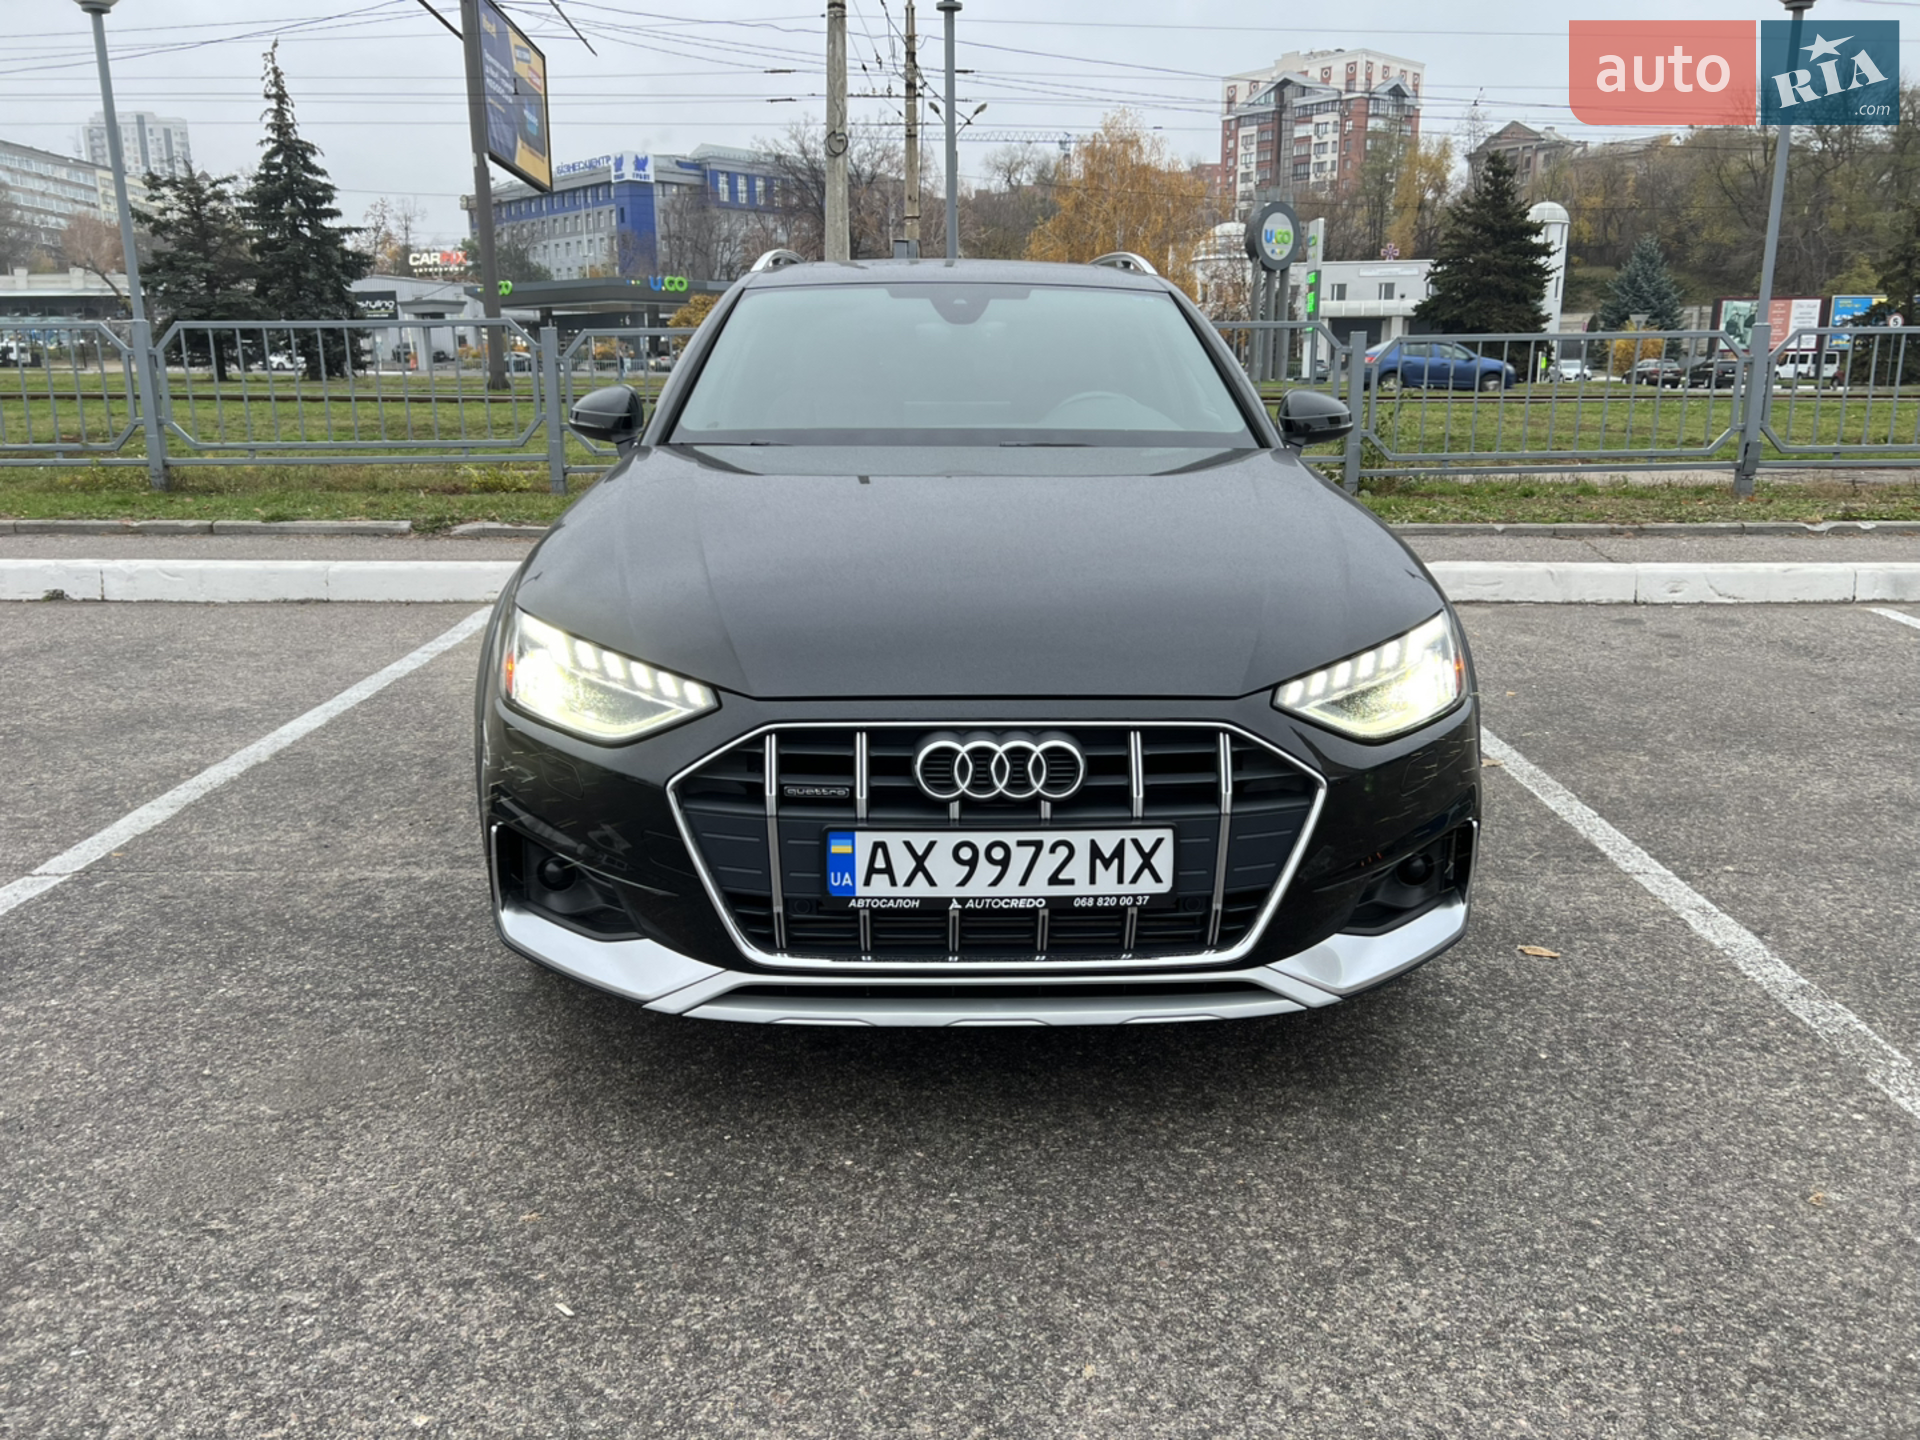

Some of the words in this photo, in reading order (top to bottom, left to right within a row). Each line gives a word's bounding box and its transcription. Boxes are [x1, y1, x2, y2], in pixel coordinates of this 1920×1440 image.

[1892, 317, 1899, 326] 5
[787, 788, 846, 796] quattro
[863, 840, 938, 887] AX
[952, 839, 1075, 887] 9972
[1089, 837, 1165, 885] MX
[831, 872, 853, 886] UA
[848, 899, 920, 909] АВТОСАЛОН
[965, 898, 1046, 909] AUTOCREDO
[1073, 897, 1094, 907] 068
[1097, 897, 1117, 907] 820
[1119, 896, 1133, 906] 00
[1136, 895, 1150, 905] 37
